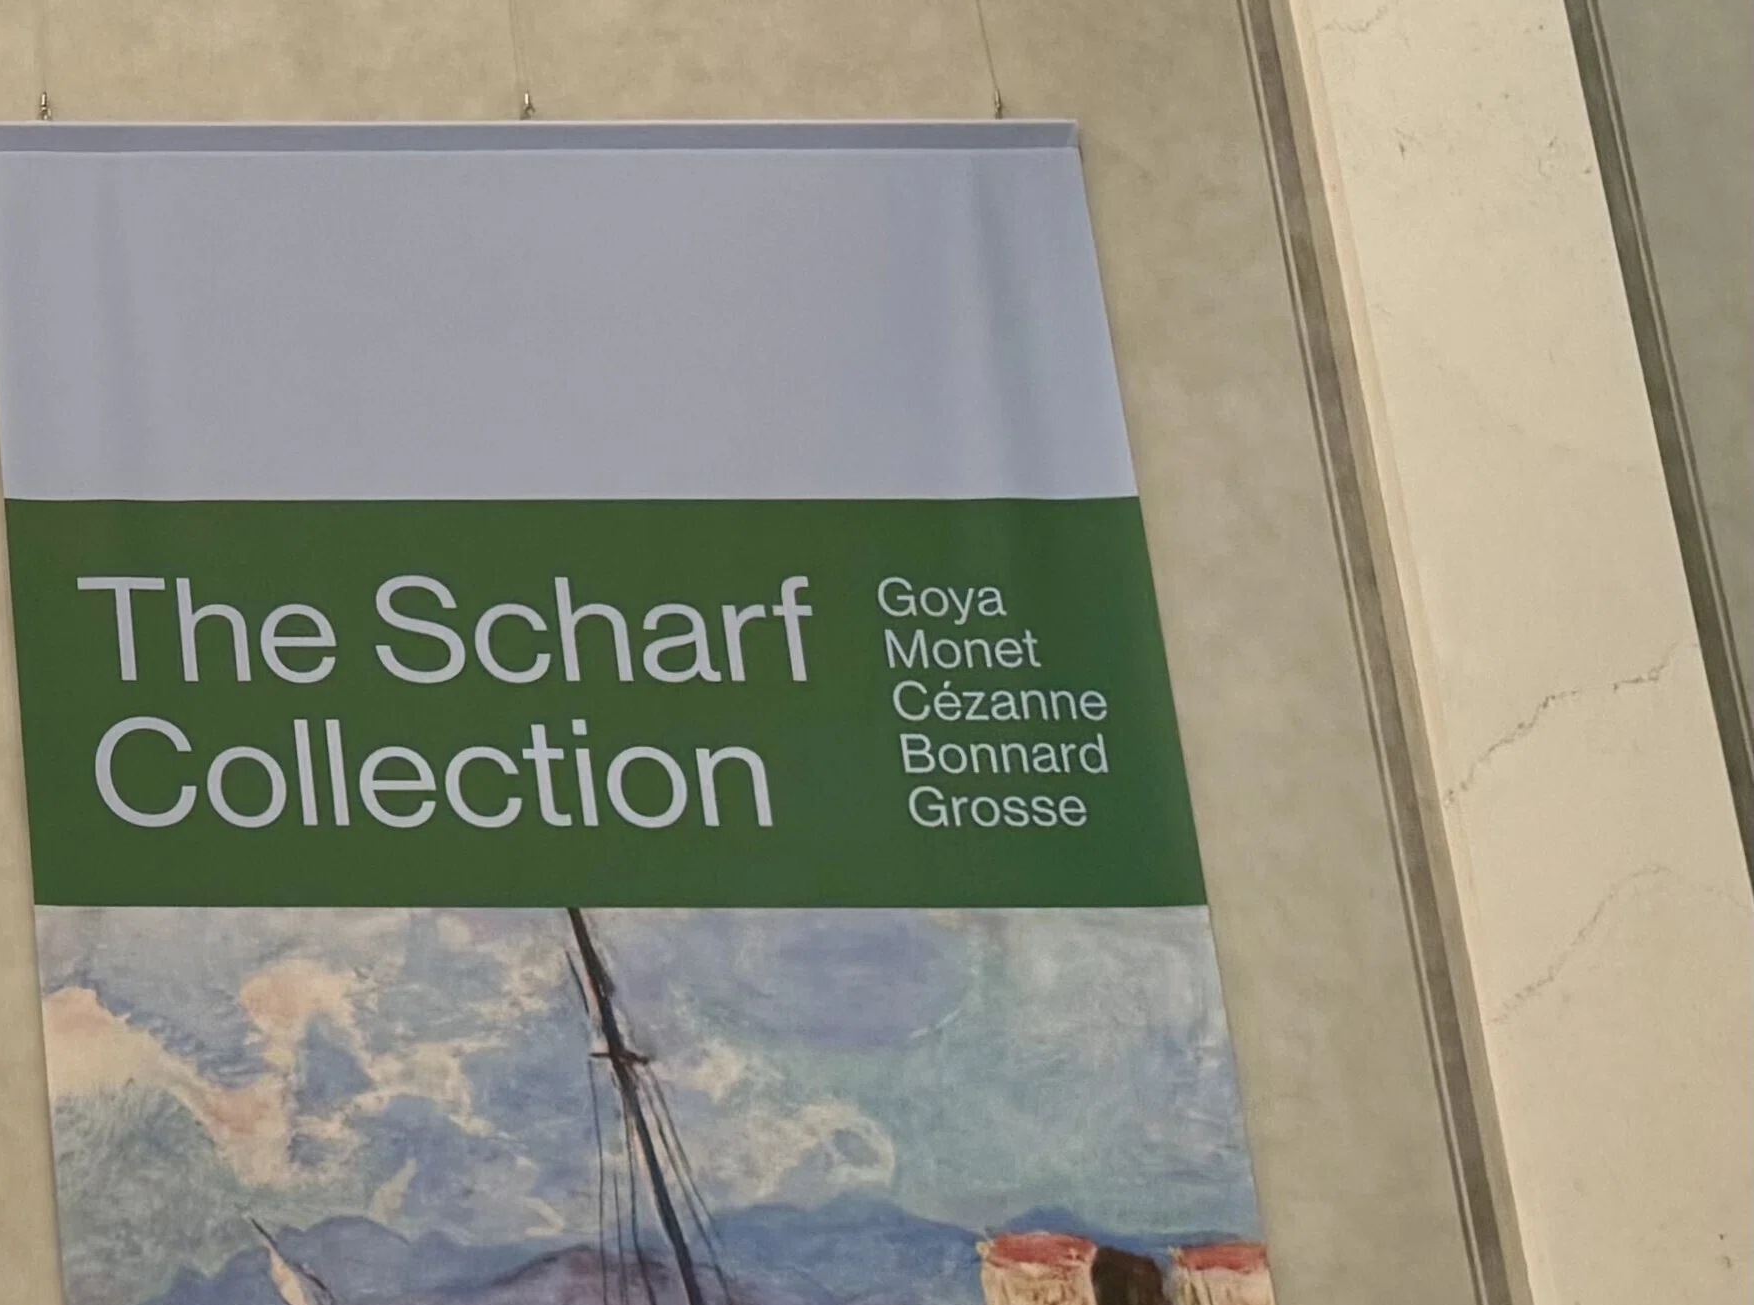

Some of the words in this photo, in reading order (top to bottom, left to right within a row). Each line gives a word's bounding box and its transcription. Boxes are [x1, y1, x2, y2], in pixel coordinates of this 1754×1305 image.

[877, 576, 1008, 626] Goya
[78, 577, 337, 686] The
[376, 576, 814, 686] Scharf
[884, 629, 1042, 670] Monet
[892, 680, 1108, 722] Cézanne
[96, 717, 774, 830] Collection
[899, 733, 1110, 775] Bonnard
[908, 786, 1088, 828] Grosse
